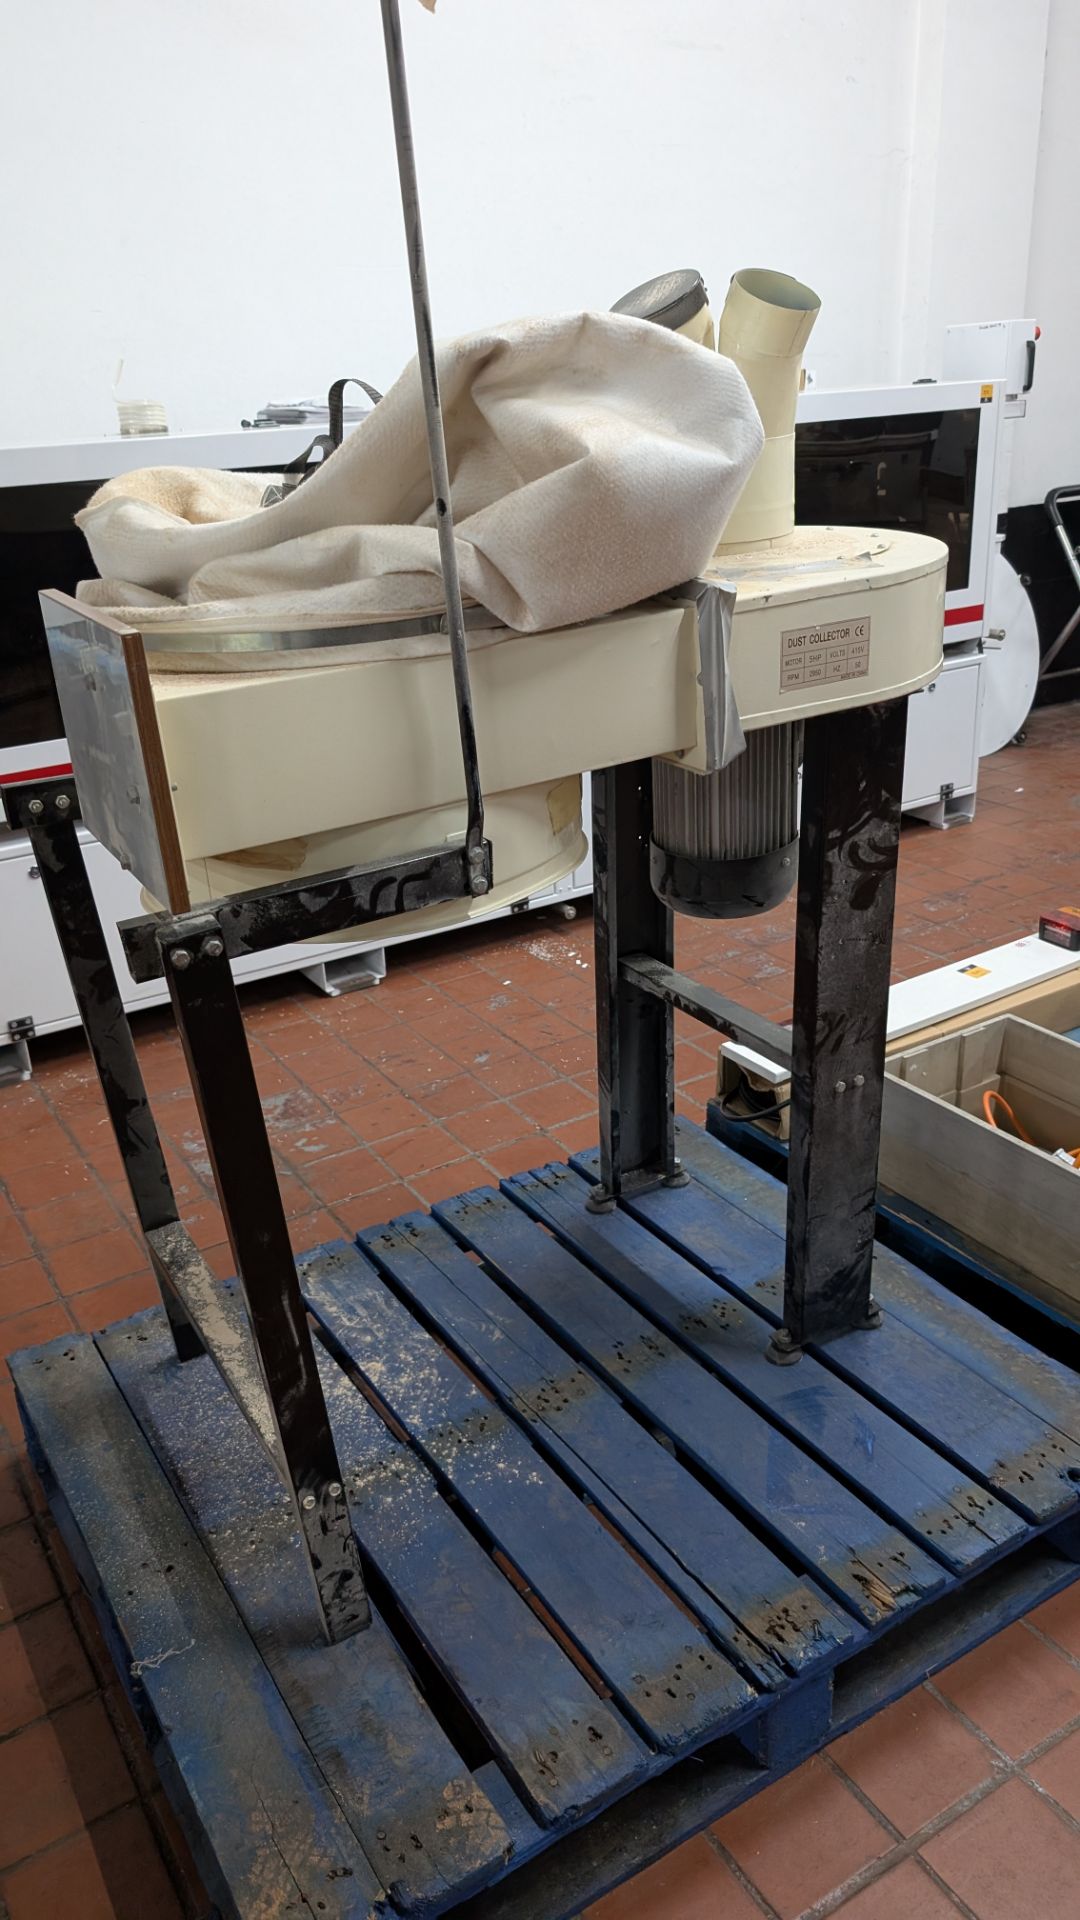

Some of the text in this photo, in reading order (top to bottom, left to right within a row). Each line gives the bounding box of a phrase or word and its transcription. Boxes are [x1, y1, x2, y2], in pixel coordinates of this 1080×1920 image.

[788, 636, 807, 649] DUST
[809, 628, 850, 644] COLLECTOR
[785, 646, 865, 667] MOTOR 5HP VOLTS 415V
[787, 673, 800, 681] RPM
